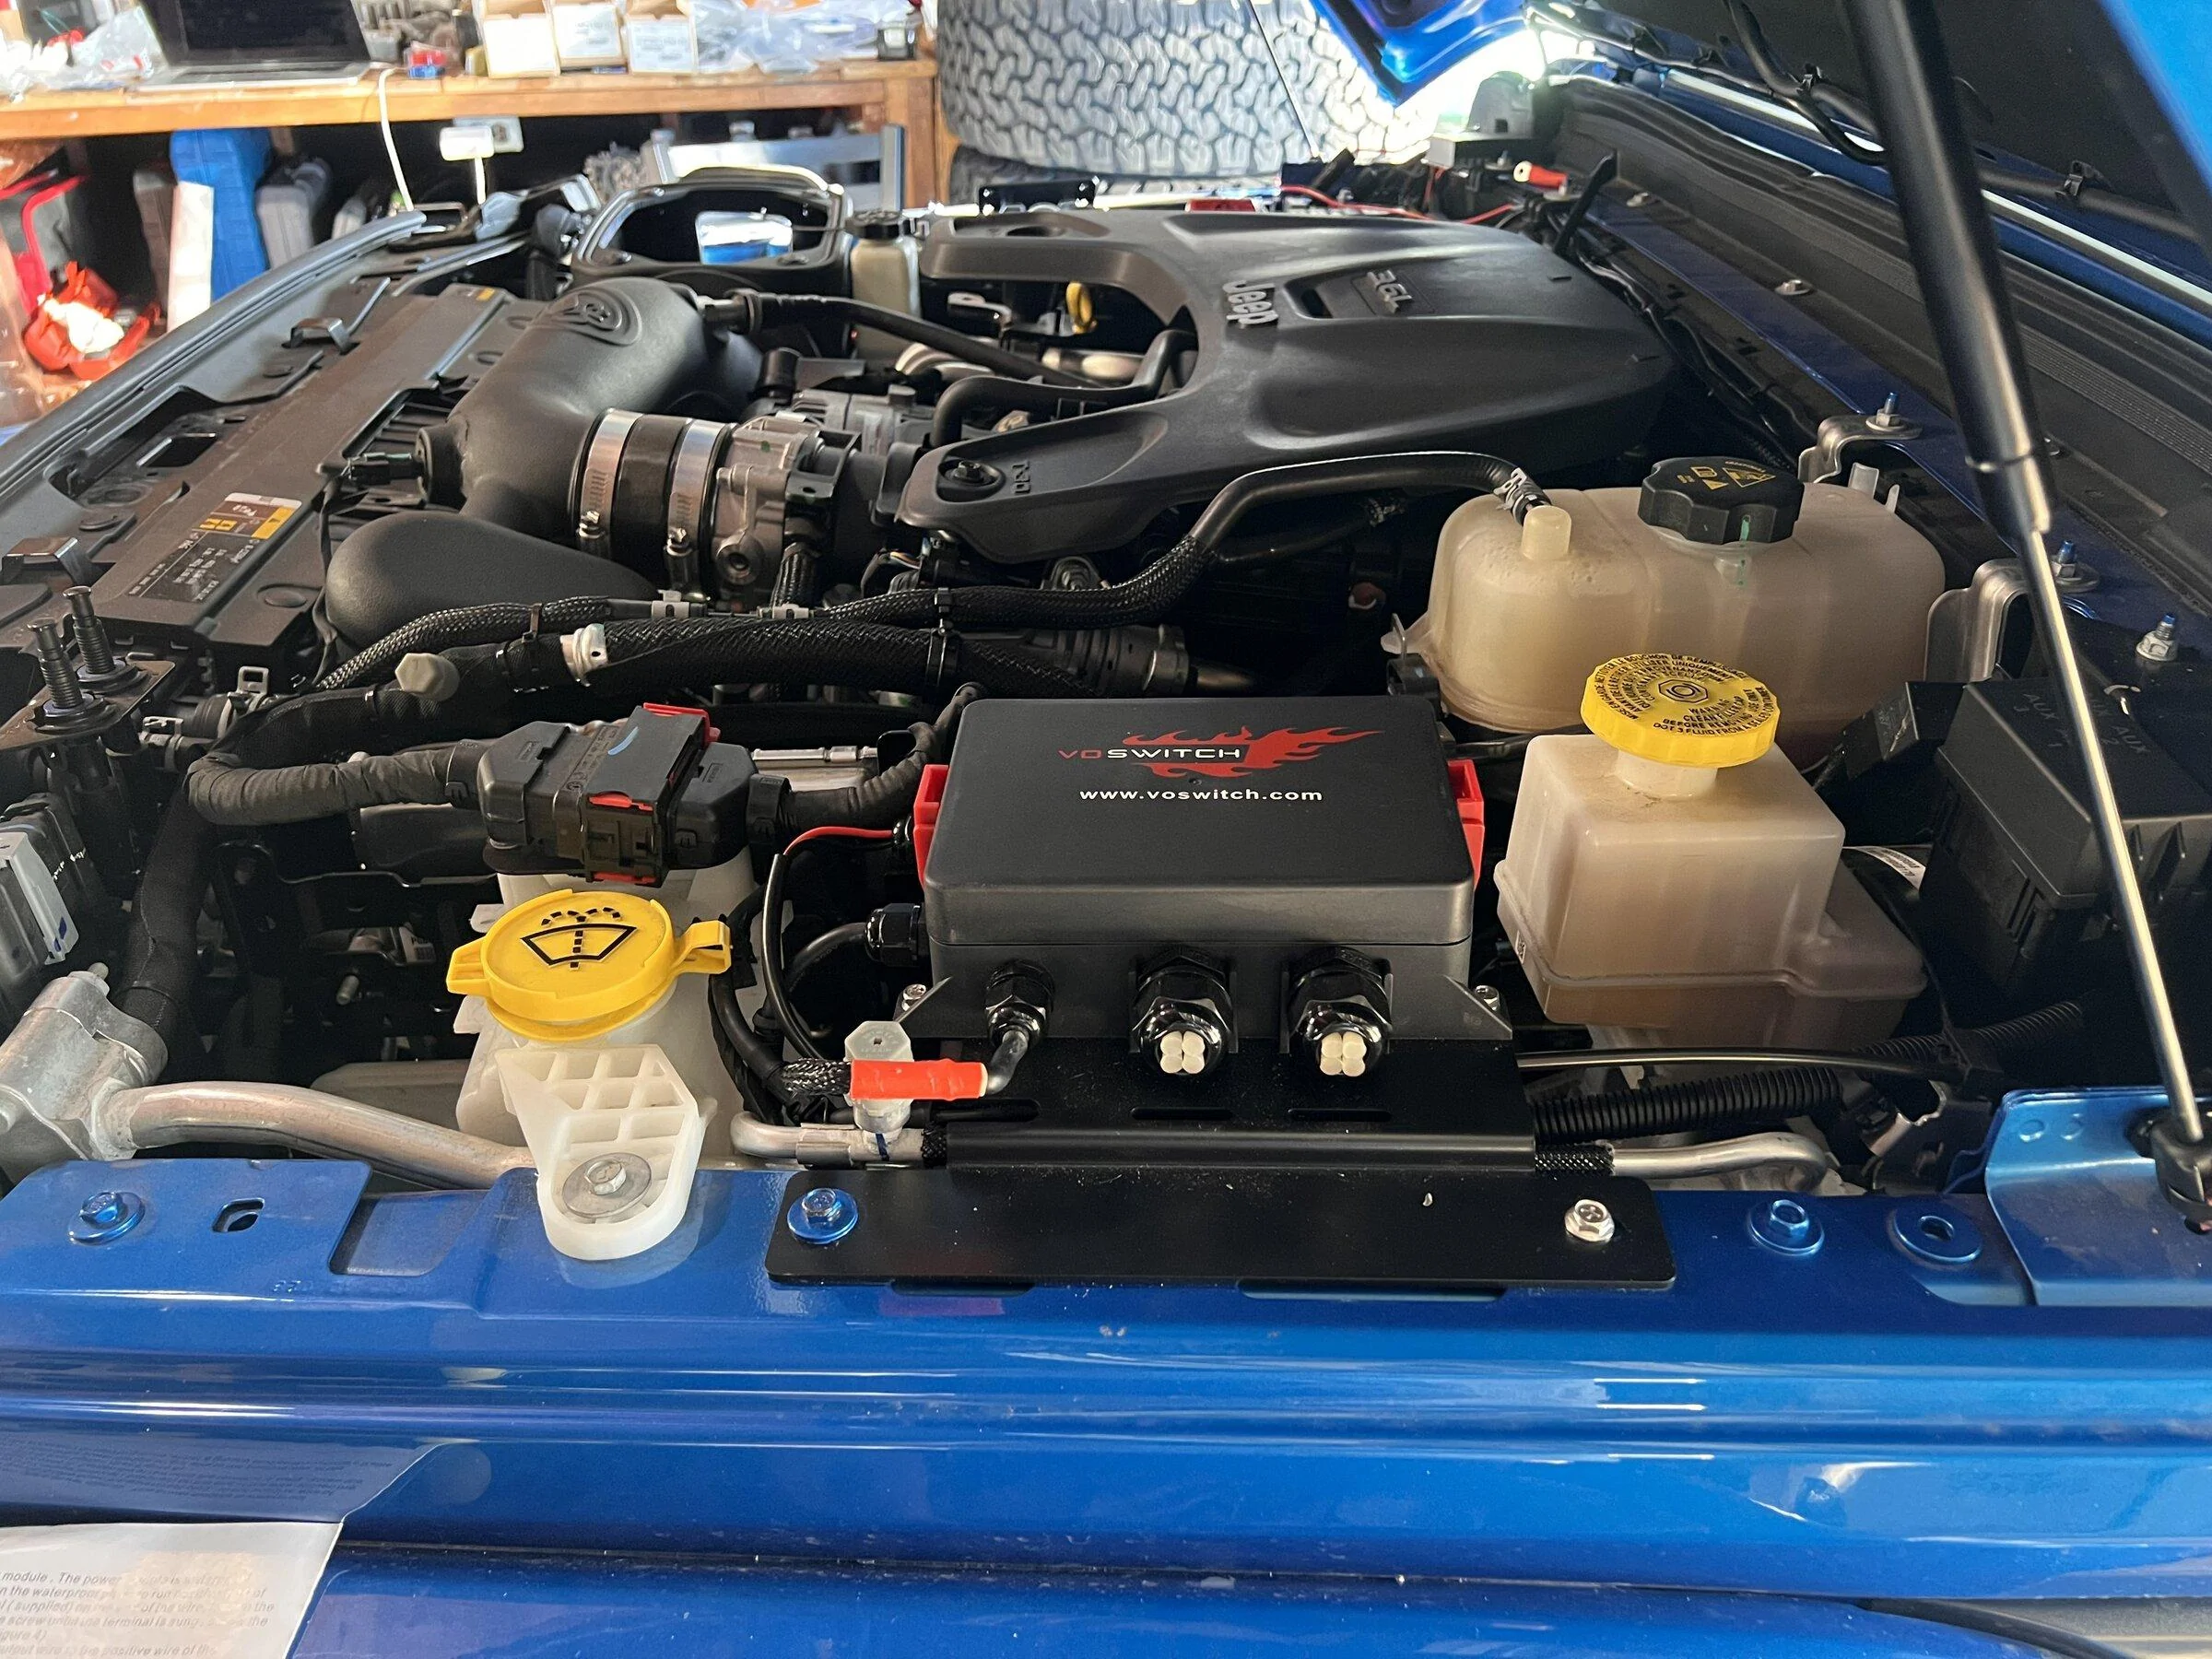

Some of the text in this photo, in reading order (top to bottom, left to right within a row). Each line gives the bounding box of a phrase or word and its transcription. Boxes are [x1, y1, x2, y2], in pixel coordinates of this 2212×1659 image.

[1222, 279, 1279, 324] Jeep
[1621, 653, 1668, 663] BOUCHON
[1626, 658, 1668, 669] UTILISER
[1671, 660, 1737, 680] UNIQUEMENT
[1683, 713, 1719, 722] CLEAN
[1713, 704, 1745, 719] FILLER
[1688, 698, 1732, 714] WARNING
[2023, 693, 2059, 720] AUX
[1661, 717, 1706, 728] BEFORE
[1706, 711, 1755, 728] REMOVING
[1652, 722, 1675, 731] DOT
[1714, 724, 1745, 735] FROM
[2111, 725, 2151, 753] AUX
[1058, 748, 1241, 759] VOSWITCH
[1079, 788, 1324, 801] www.voswitch.com
[2, 1571, 48, 1583] module
[58, 1571, 81, 1583] The
[10, 1585, 29, 1596] the
